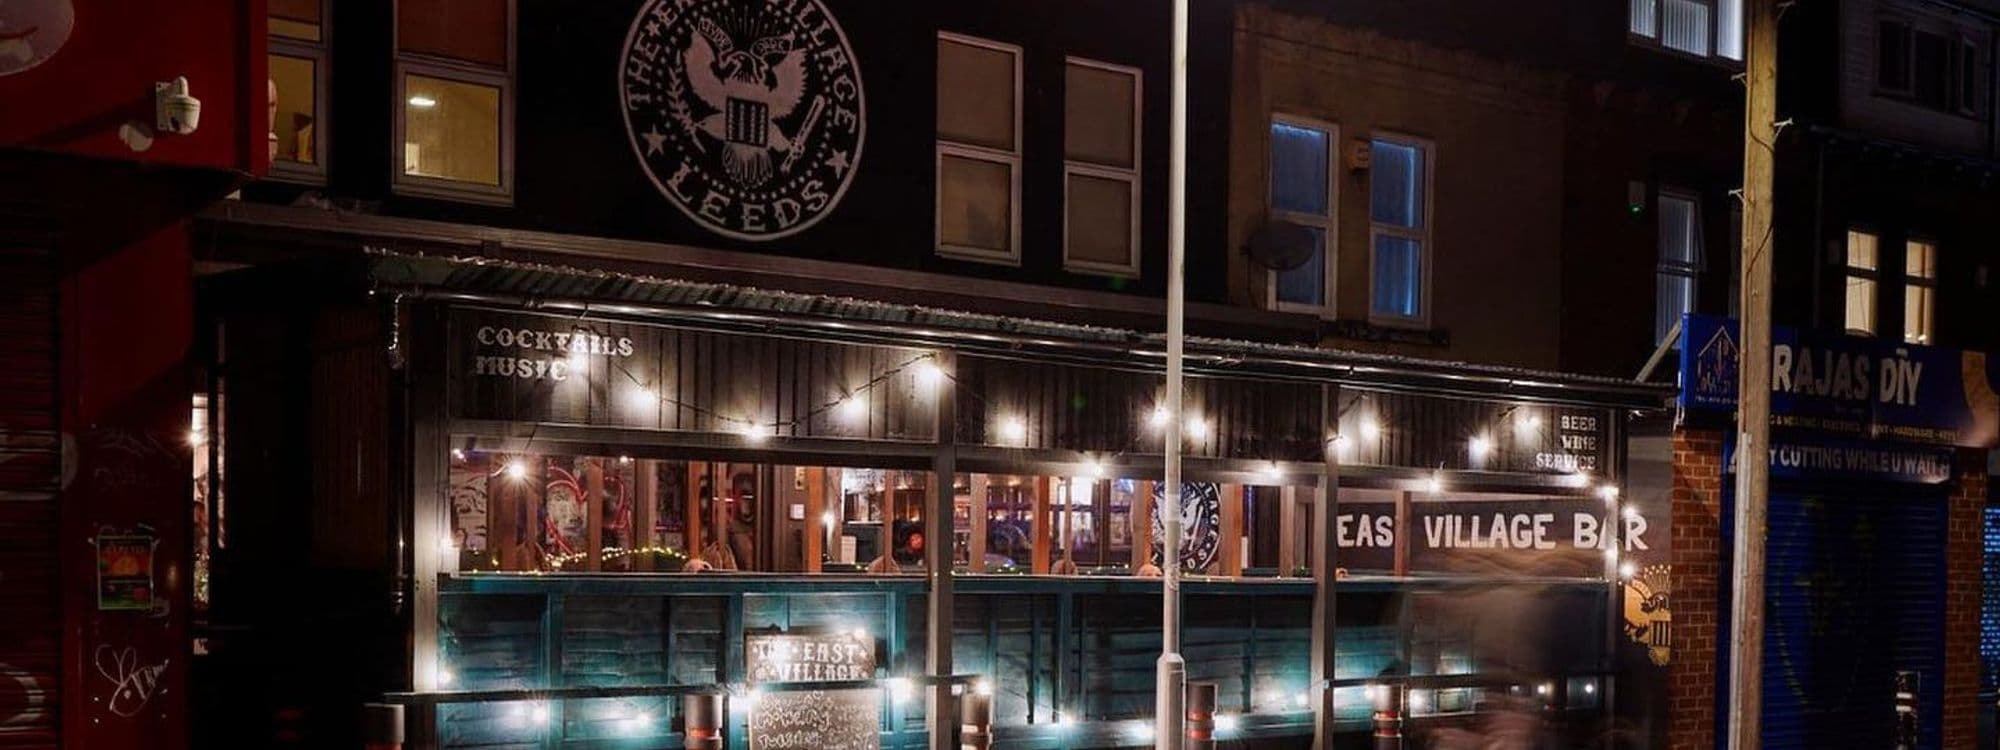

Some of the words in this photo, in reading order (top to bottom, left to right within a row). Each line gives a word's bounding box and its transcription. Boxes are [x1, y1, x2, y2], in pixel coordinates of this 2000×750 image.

[626, 33, 661, 110] THE
[767, 0, 857, 134] ILLAGE
[667, 162, 829, 232] LEEDS
[476, 325, 634, 357] COCKTAILS
[475, 355, 568, 382] MUSIC
[1772, 344, 1871, 400] RAJAS
[1879, 355, 1922, 407] DIY
[1560, 415, 1597, 431] BEER
[1560, 434, 1597, 450] WINE
[1535, 452, 1597, 470] SERVICE
[1780, 445, 1841, 470] CUTTING
[1845, 448, 1889, 473] WHILE
[1892, 451, 1900, 473] U
[1336, 513, 1394, 548] EAS
[1424, 513, 1556, 550] VILLAGE
[803, 642, 859, 663] EAST
